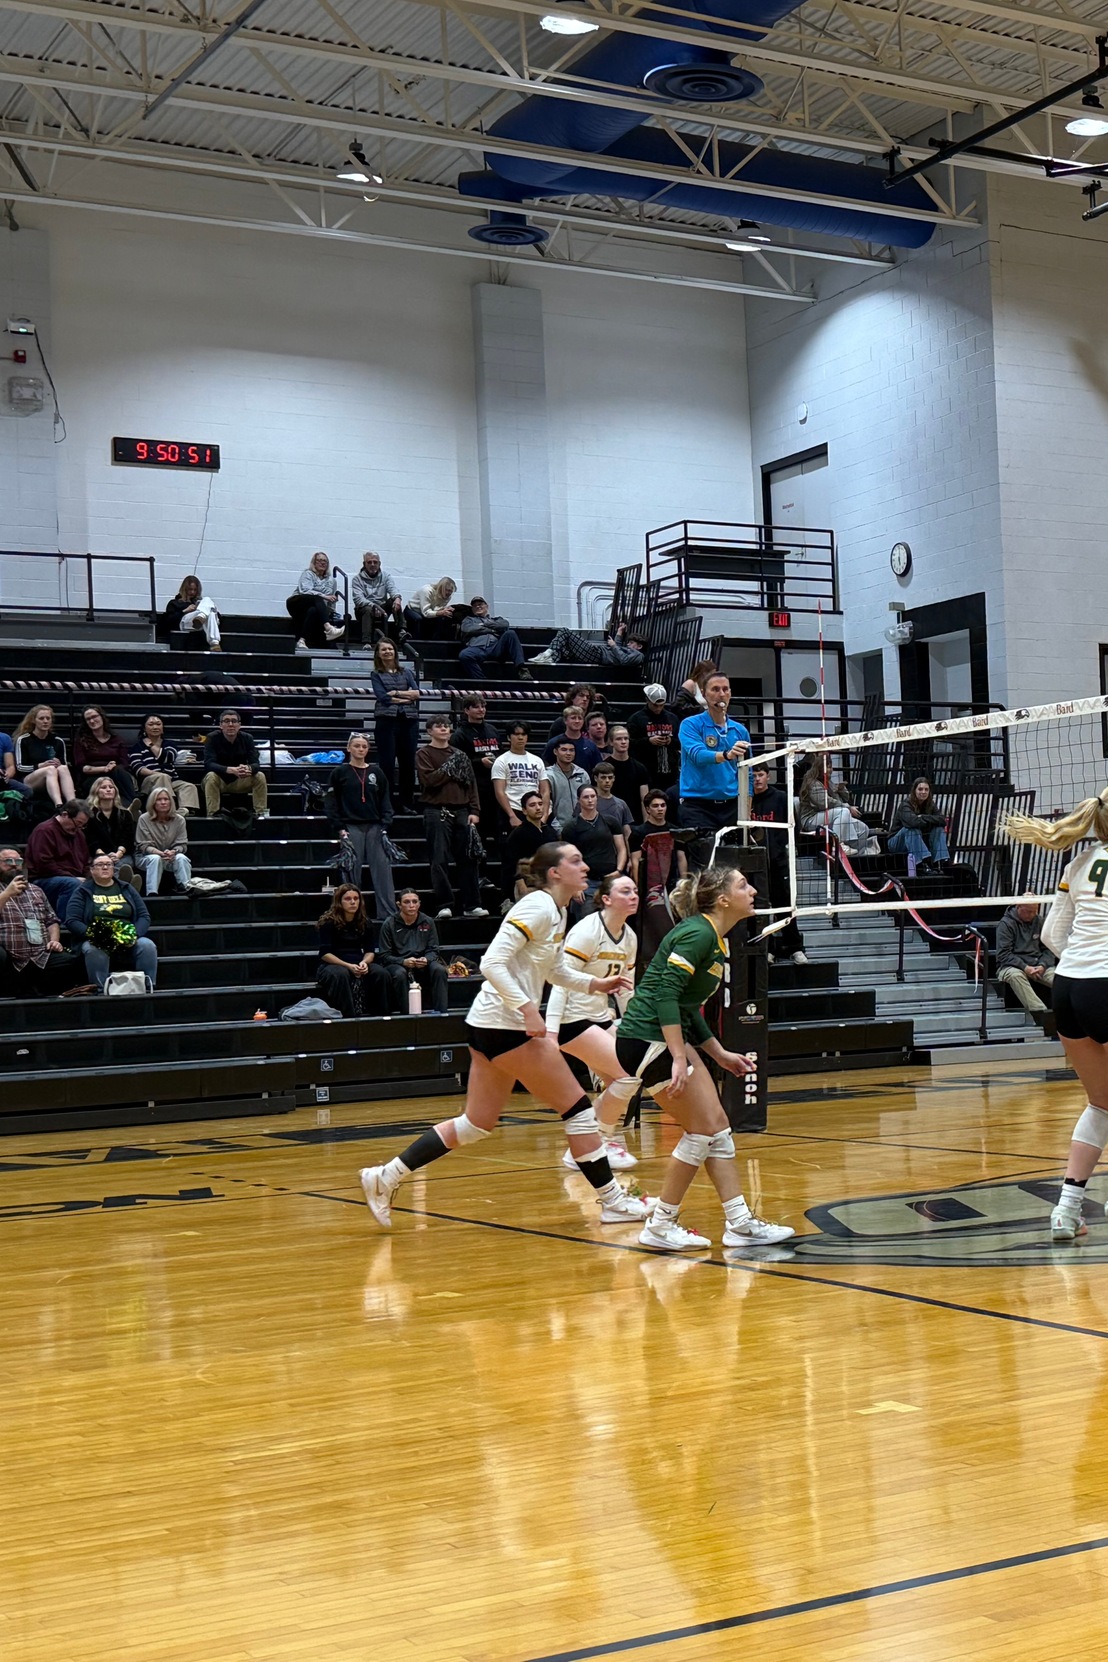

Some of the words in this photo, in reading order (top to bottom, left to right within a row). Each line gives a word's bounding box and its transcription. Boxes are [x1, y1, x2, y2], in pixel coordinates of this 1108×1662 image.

[773, 612, 788, 626] EXIT
[1056, 702, 1074, 716] Bard
[972, 715, 989, 728] Bard
[896, 726, 912, 740] Bard
[508, 762, 539, 771] WALK
